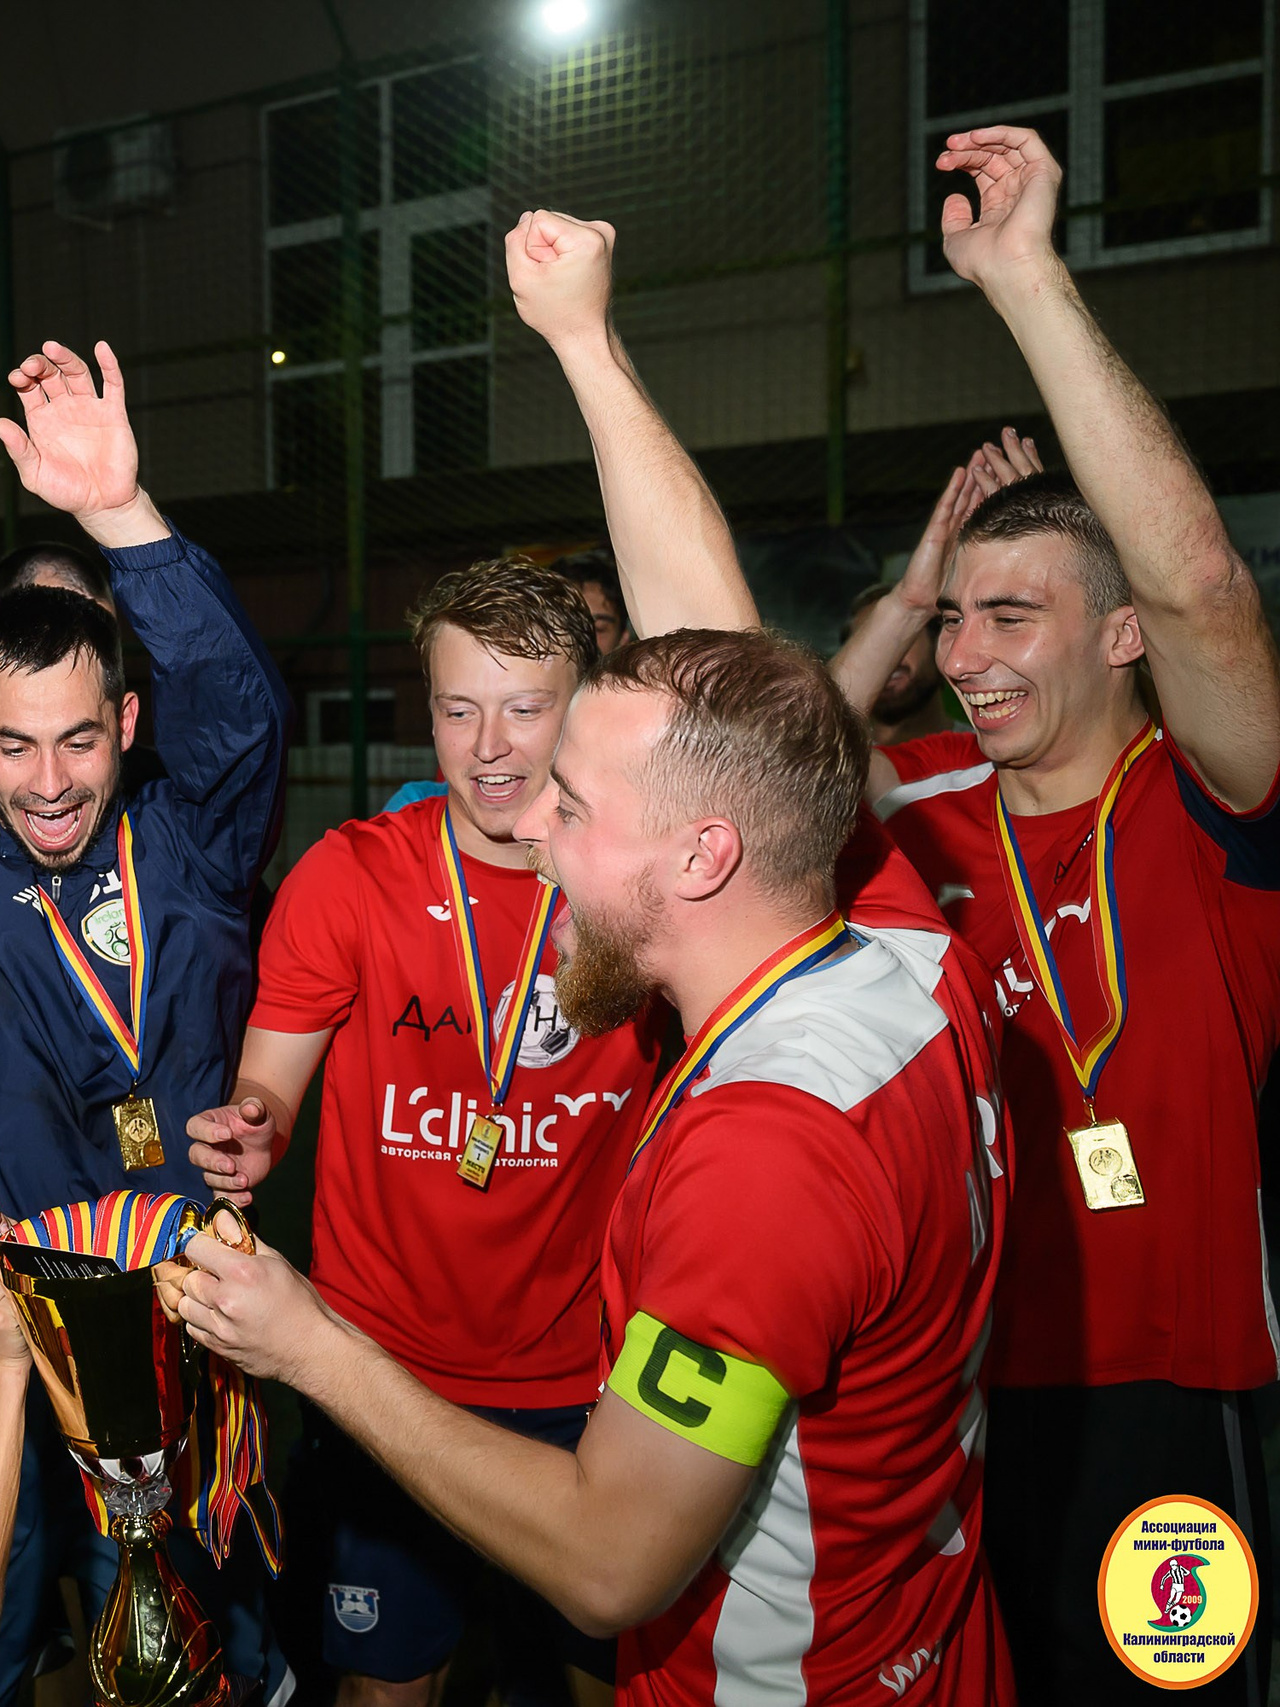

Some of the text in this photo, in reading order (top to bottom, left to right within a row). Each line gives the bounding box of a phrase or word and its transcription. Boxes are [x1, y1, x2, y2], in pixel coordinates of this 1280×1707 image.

[392, 995, 490, 1041] ДА
[380, 1144, 451, 1162] авторская
[637, 1326, 727, 1428] C
